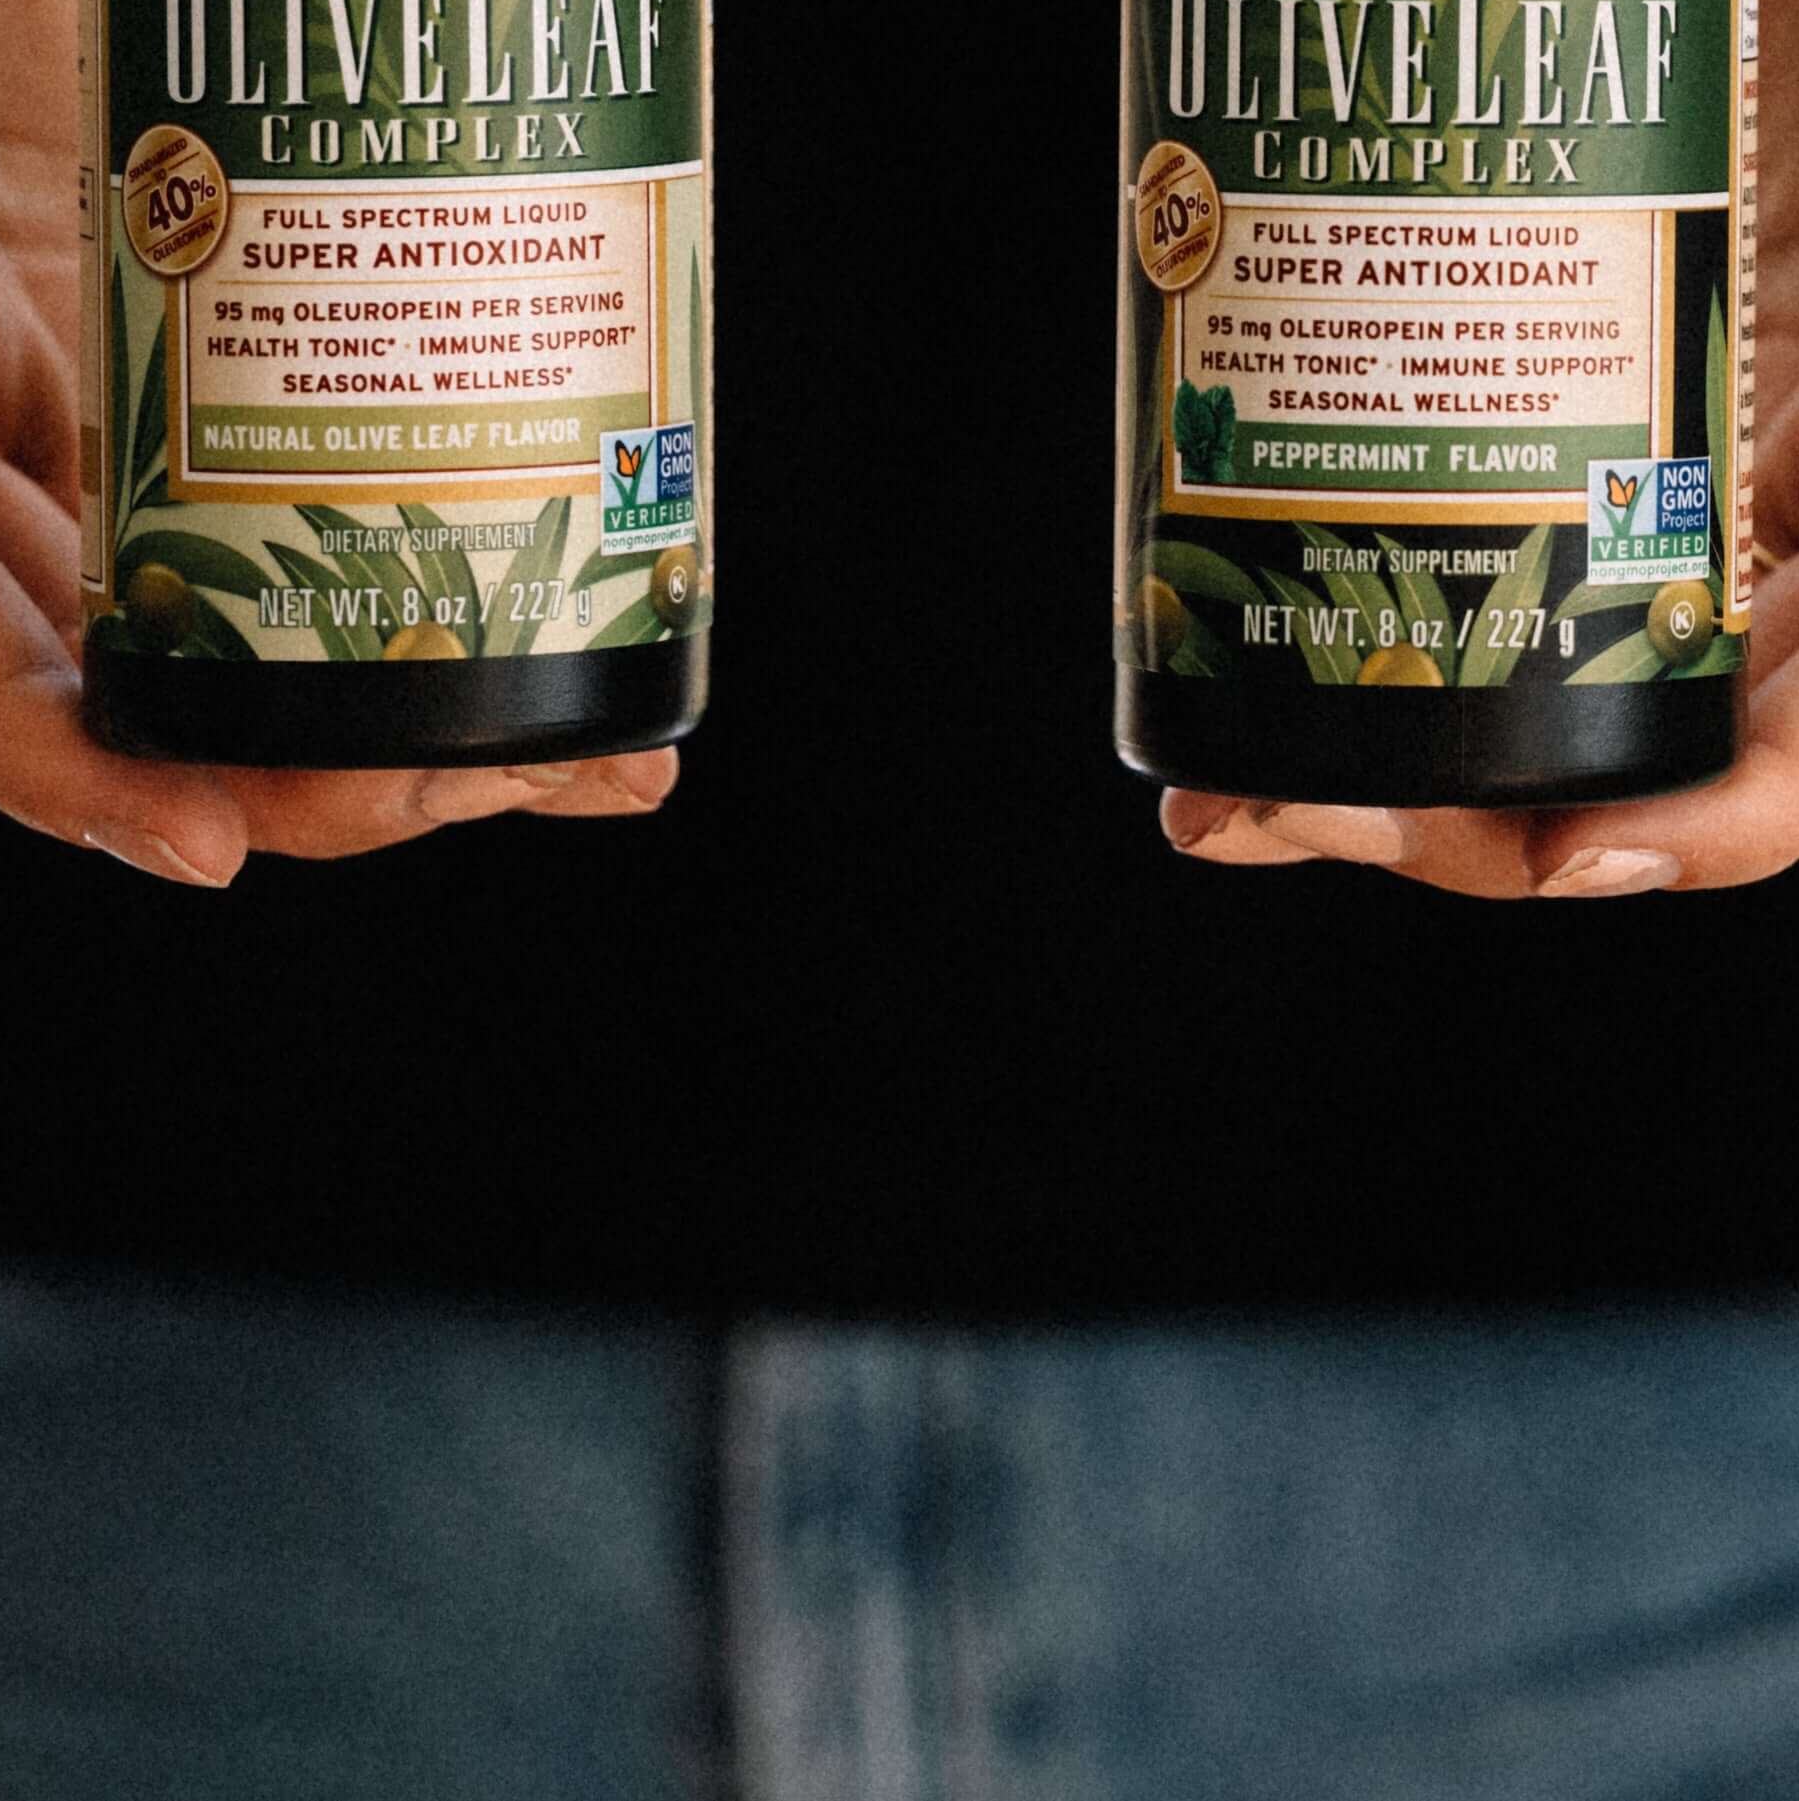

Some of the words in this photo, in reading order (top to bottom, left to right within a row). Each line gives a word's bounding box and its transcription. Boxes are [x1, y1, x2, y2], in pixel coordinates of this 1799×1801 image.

[261, 113, 585, 165] COMPLEX
[1254, 130, 1580, 184] COMPLEX
[149, 174, 216, 231] 40%
[263, 209, 330, 229] FULL
[342, 206, 491, 228] SPECTRUM
[503, 202, 586, 225] LIQUID
[1153, 191, 1210, 246] 40%
[1253, 223, 1316, 245] FULL
[1328, 225, 1476, 247] SPECTRUM
[1489, 226, 1579, 248] LIQUID
[243, 243, 357, 269] SUPER
[373, 234, 605, 268] ANTIOXIDANT
[1234, 256, 1342, 284] SUPER
[1358, 260, 1599, 287] ANTIOXIDANT
[215, 302, 242, 322] 95
[251, 305, 284, 326] mg
[294, 301, 461, 322] OLEUROPEIN
[472, 298, 520, 318] PER
[530, 291, 624, 316] SERVING
[1207, 316, 1233, 336] 95
[1241, 320, 1271, 341] mg
[1280, 318, 1444, 340] OLEUROPEIN
[1455, 321, 1504, 340] PER
[1515, 320, 1620, 340] SERVING
[207, 338, 298, 358] HEALTH
[420, 333, 521, 354] IMMUNE
[1201, 351, 1284, 373] HEALTH
[1402, 357, 1505, 377] IMMUNE
[283, 372, 423, 393] SEASONAL
[1268, 390, 1403, 412] SEASONAL
[204, 425, 315, 451] NATURAL
[325, 424, 401, 450] OLIVE
[414, 422, 477, 448] LEAF
[488, 417, 581, 447] FLAVOR
[661, 431, 692, 455] NON
[661, 456, 692, 477] GMO
[1253, 441, 1429, 472] PEPPERMINT
[1450, 442, 1557, 472] FLAVOR
[661, 479, 693, 498] Project
[1663, 465, 1705, 488] NON
[1662, 488, 1706, 510] GMO
[610, 502, 693, 529] VERIFIED
[1662, 512, 1704, 532] Project
[322, 528, 402, 554] DIETARY
[410, 522, 537, 552] SUPPLEMENT
[603, 526, 696, 550] nongmoproject.org
[1599, 536, 1705, 559] VERIFIED
[1303, 547, 1380, 573] DIETARY
[1389, 548, 1519, 575] SUPPLEMENT
[1590, 561, 1708, 581] nongmoproject.org
[259, 587, 316, 627] NET
[329, 588, 390, 627] WT.
[403, 586, 420, 626] 8
[435, 595, 466, 626] oz
[480, 582, 498, 624] /
[509, 580, 563, 623] 227
[576, 585, 591, 626] g
[1244, 604, 1296, 645] NET
[1308, 607, 1365, 648] WT.
[1379, 608, 1396, 647] 8
[1412, 618, 1443, 648] oz
[1457, 608, 1471, 649] /
[1487, 608, 1546, 649] 227
[1559, 617, 1575, 658] g
